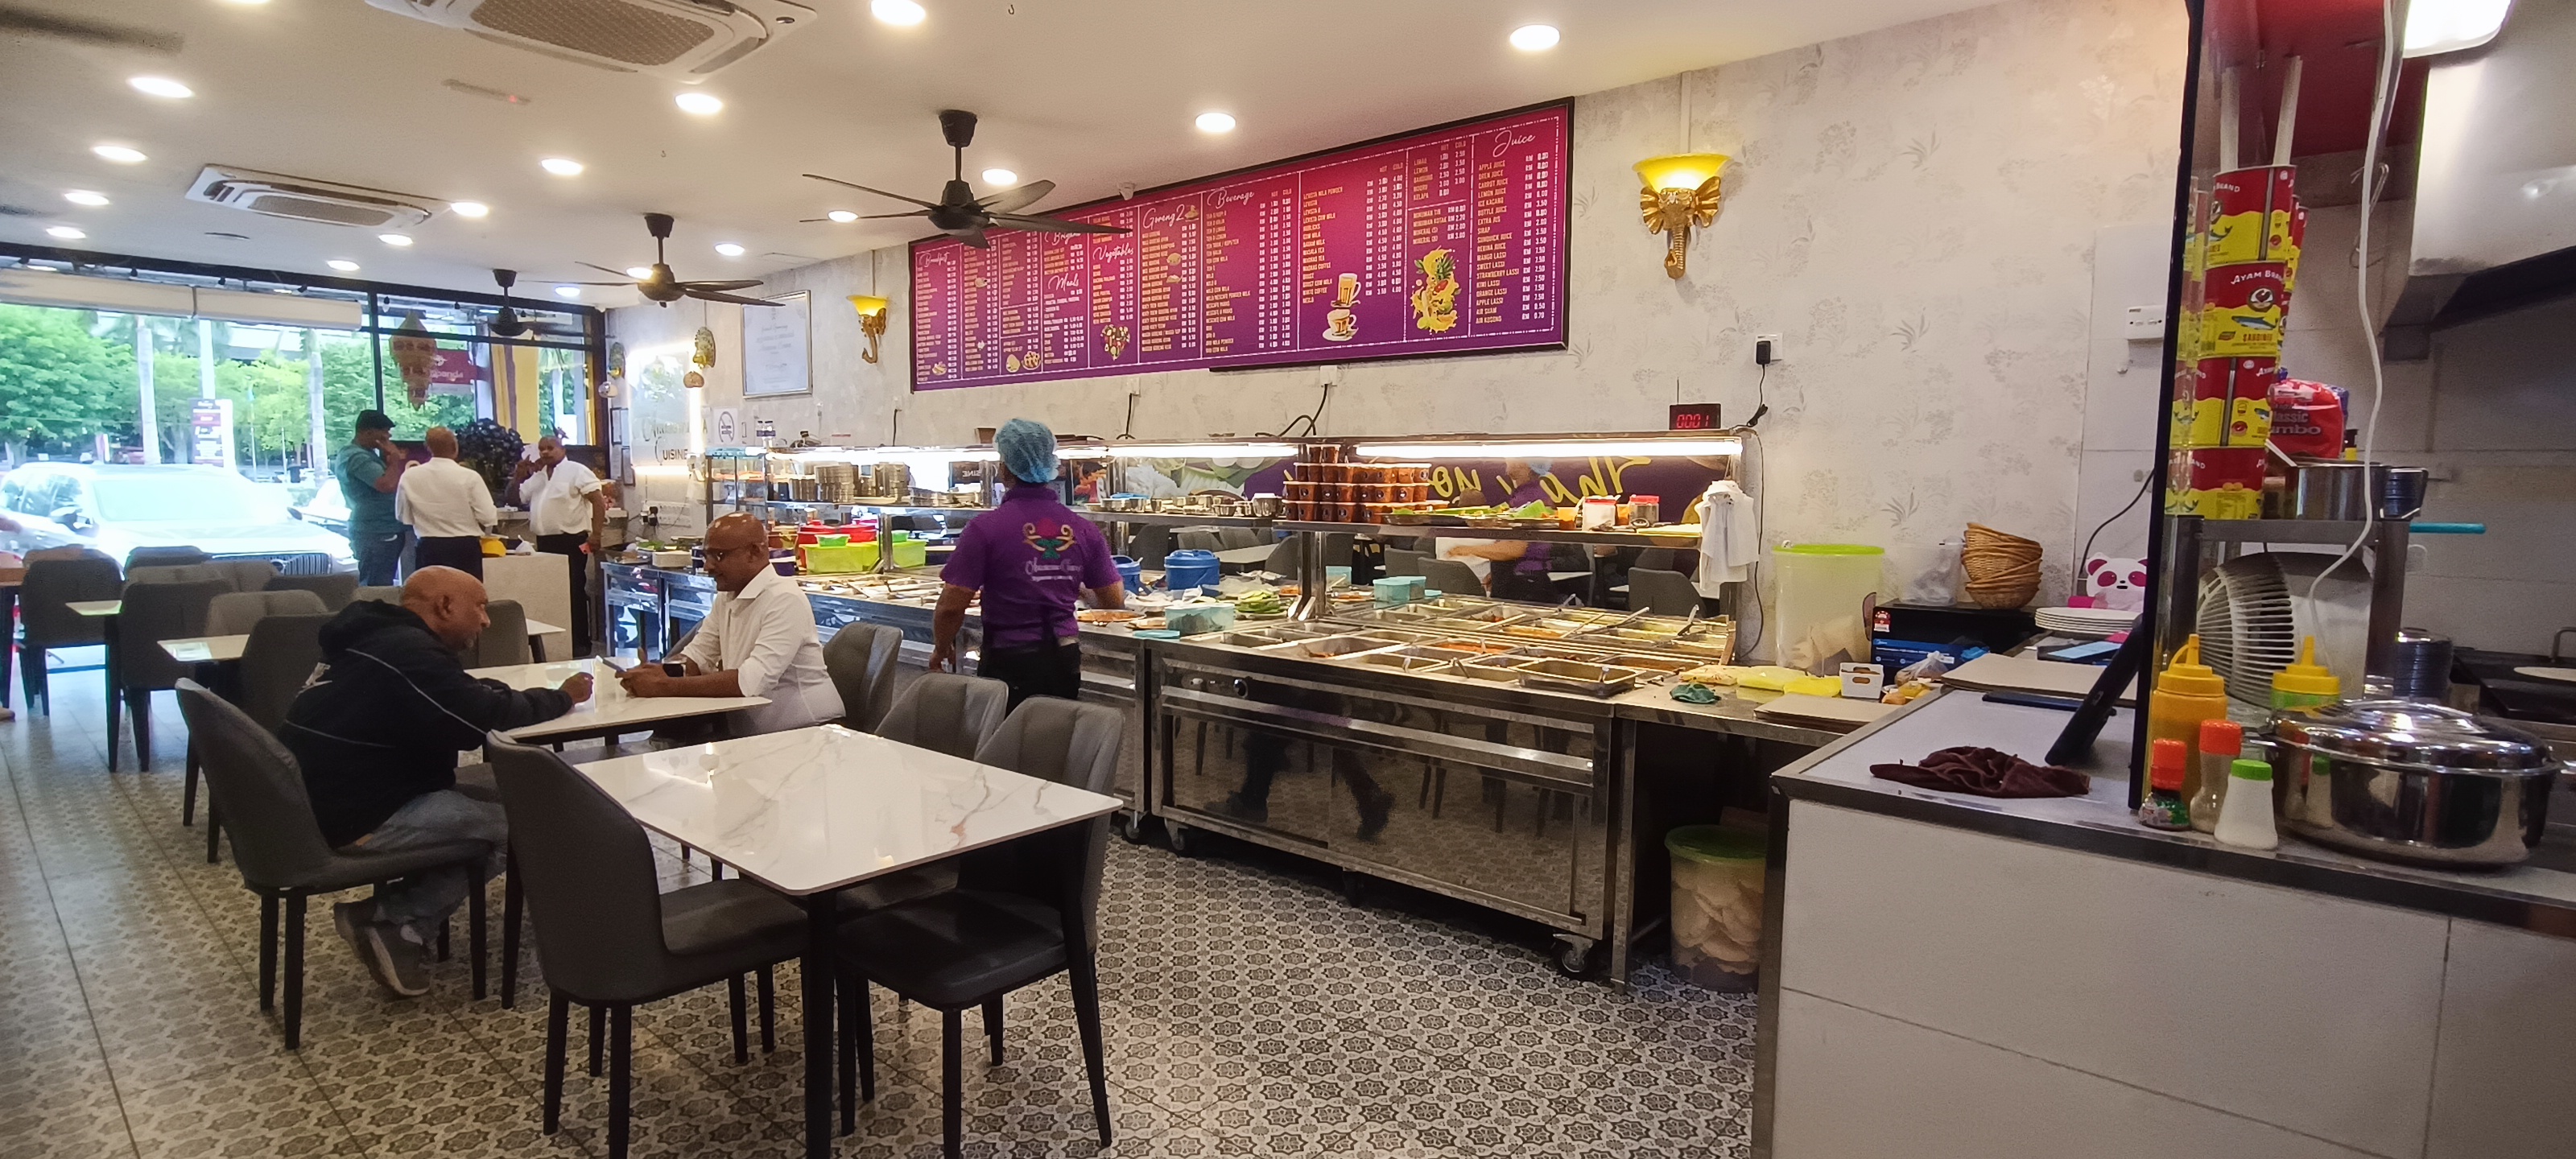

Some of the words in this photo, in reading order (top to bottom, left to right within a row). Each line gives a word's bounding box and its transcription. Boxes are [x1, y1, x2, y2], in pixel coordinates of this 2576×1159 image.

[1492, 130, 1535, 157] Juice
[1207, 188, 1254, 209] Beverage
[1093, 242, 1133, 263] Vegetables
[1048, 272, 1079, 291] Meals
[2231, 271, 2262, 285] AYAM
[1676, 414, 1709, 428] 0001
[2274, 411, 2309, 423] lassic
